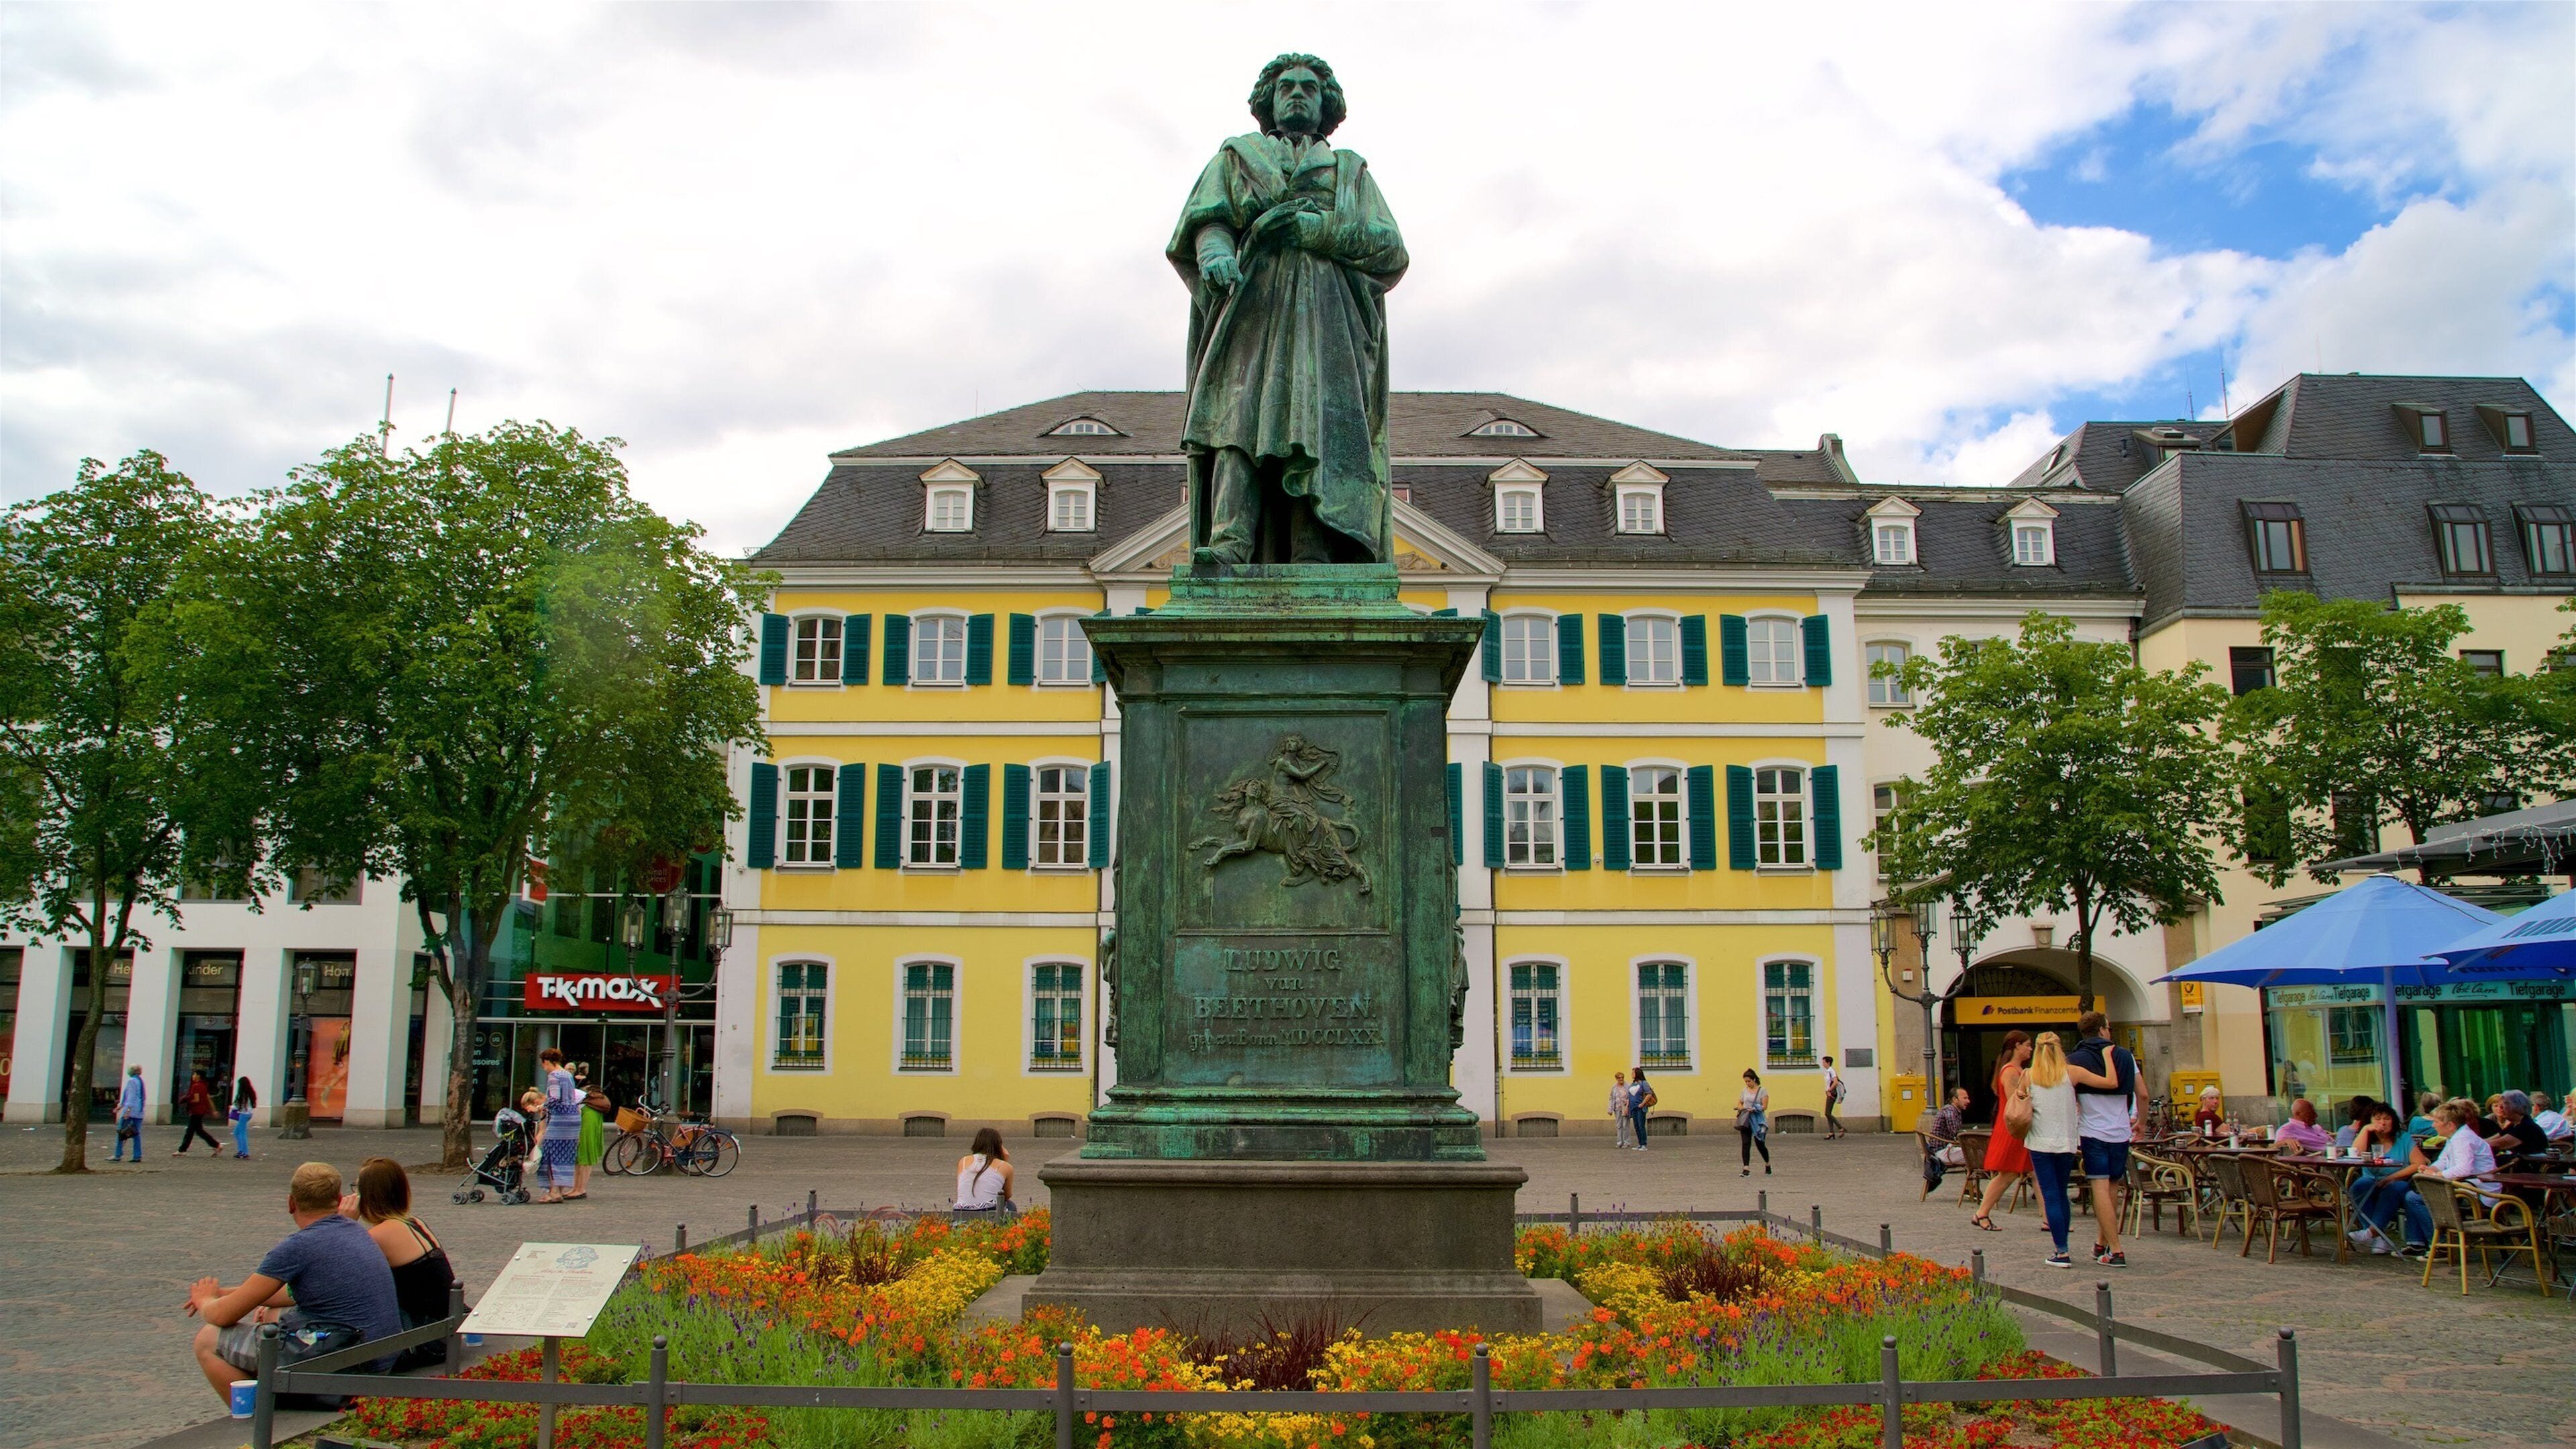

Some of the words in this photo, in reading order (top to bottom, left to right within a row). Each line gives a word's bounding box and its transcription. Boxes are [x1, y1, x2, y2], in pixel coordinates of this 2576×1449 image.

[1224, 949, 1342, 971] LUDWIG
[1265, 977, 1305, 991] van
[2508, 981, 2565, 998] Tiefgarage
[2271, 991, 2306, 1006] Tiefgarage
[2332, 986, 2370, 1002] Tiefgarage
[1997, 1006, 2034, 1015] Postbank
[472, 1058, 500, 1066] ssoires
